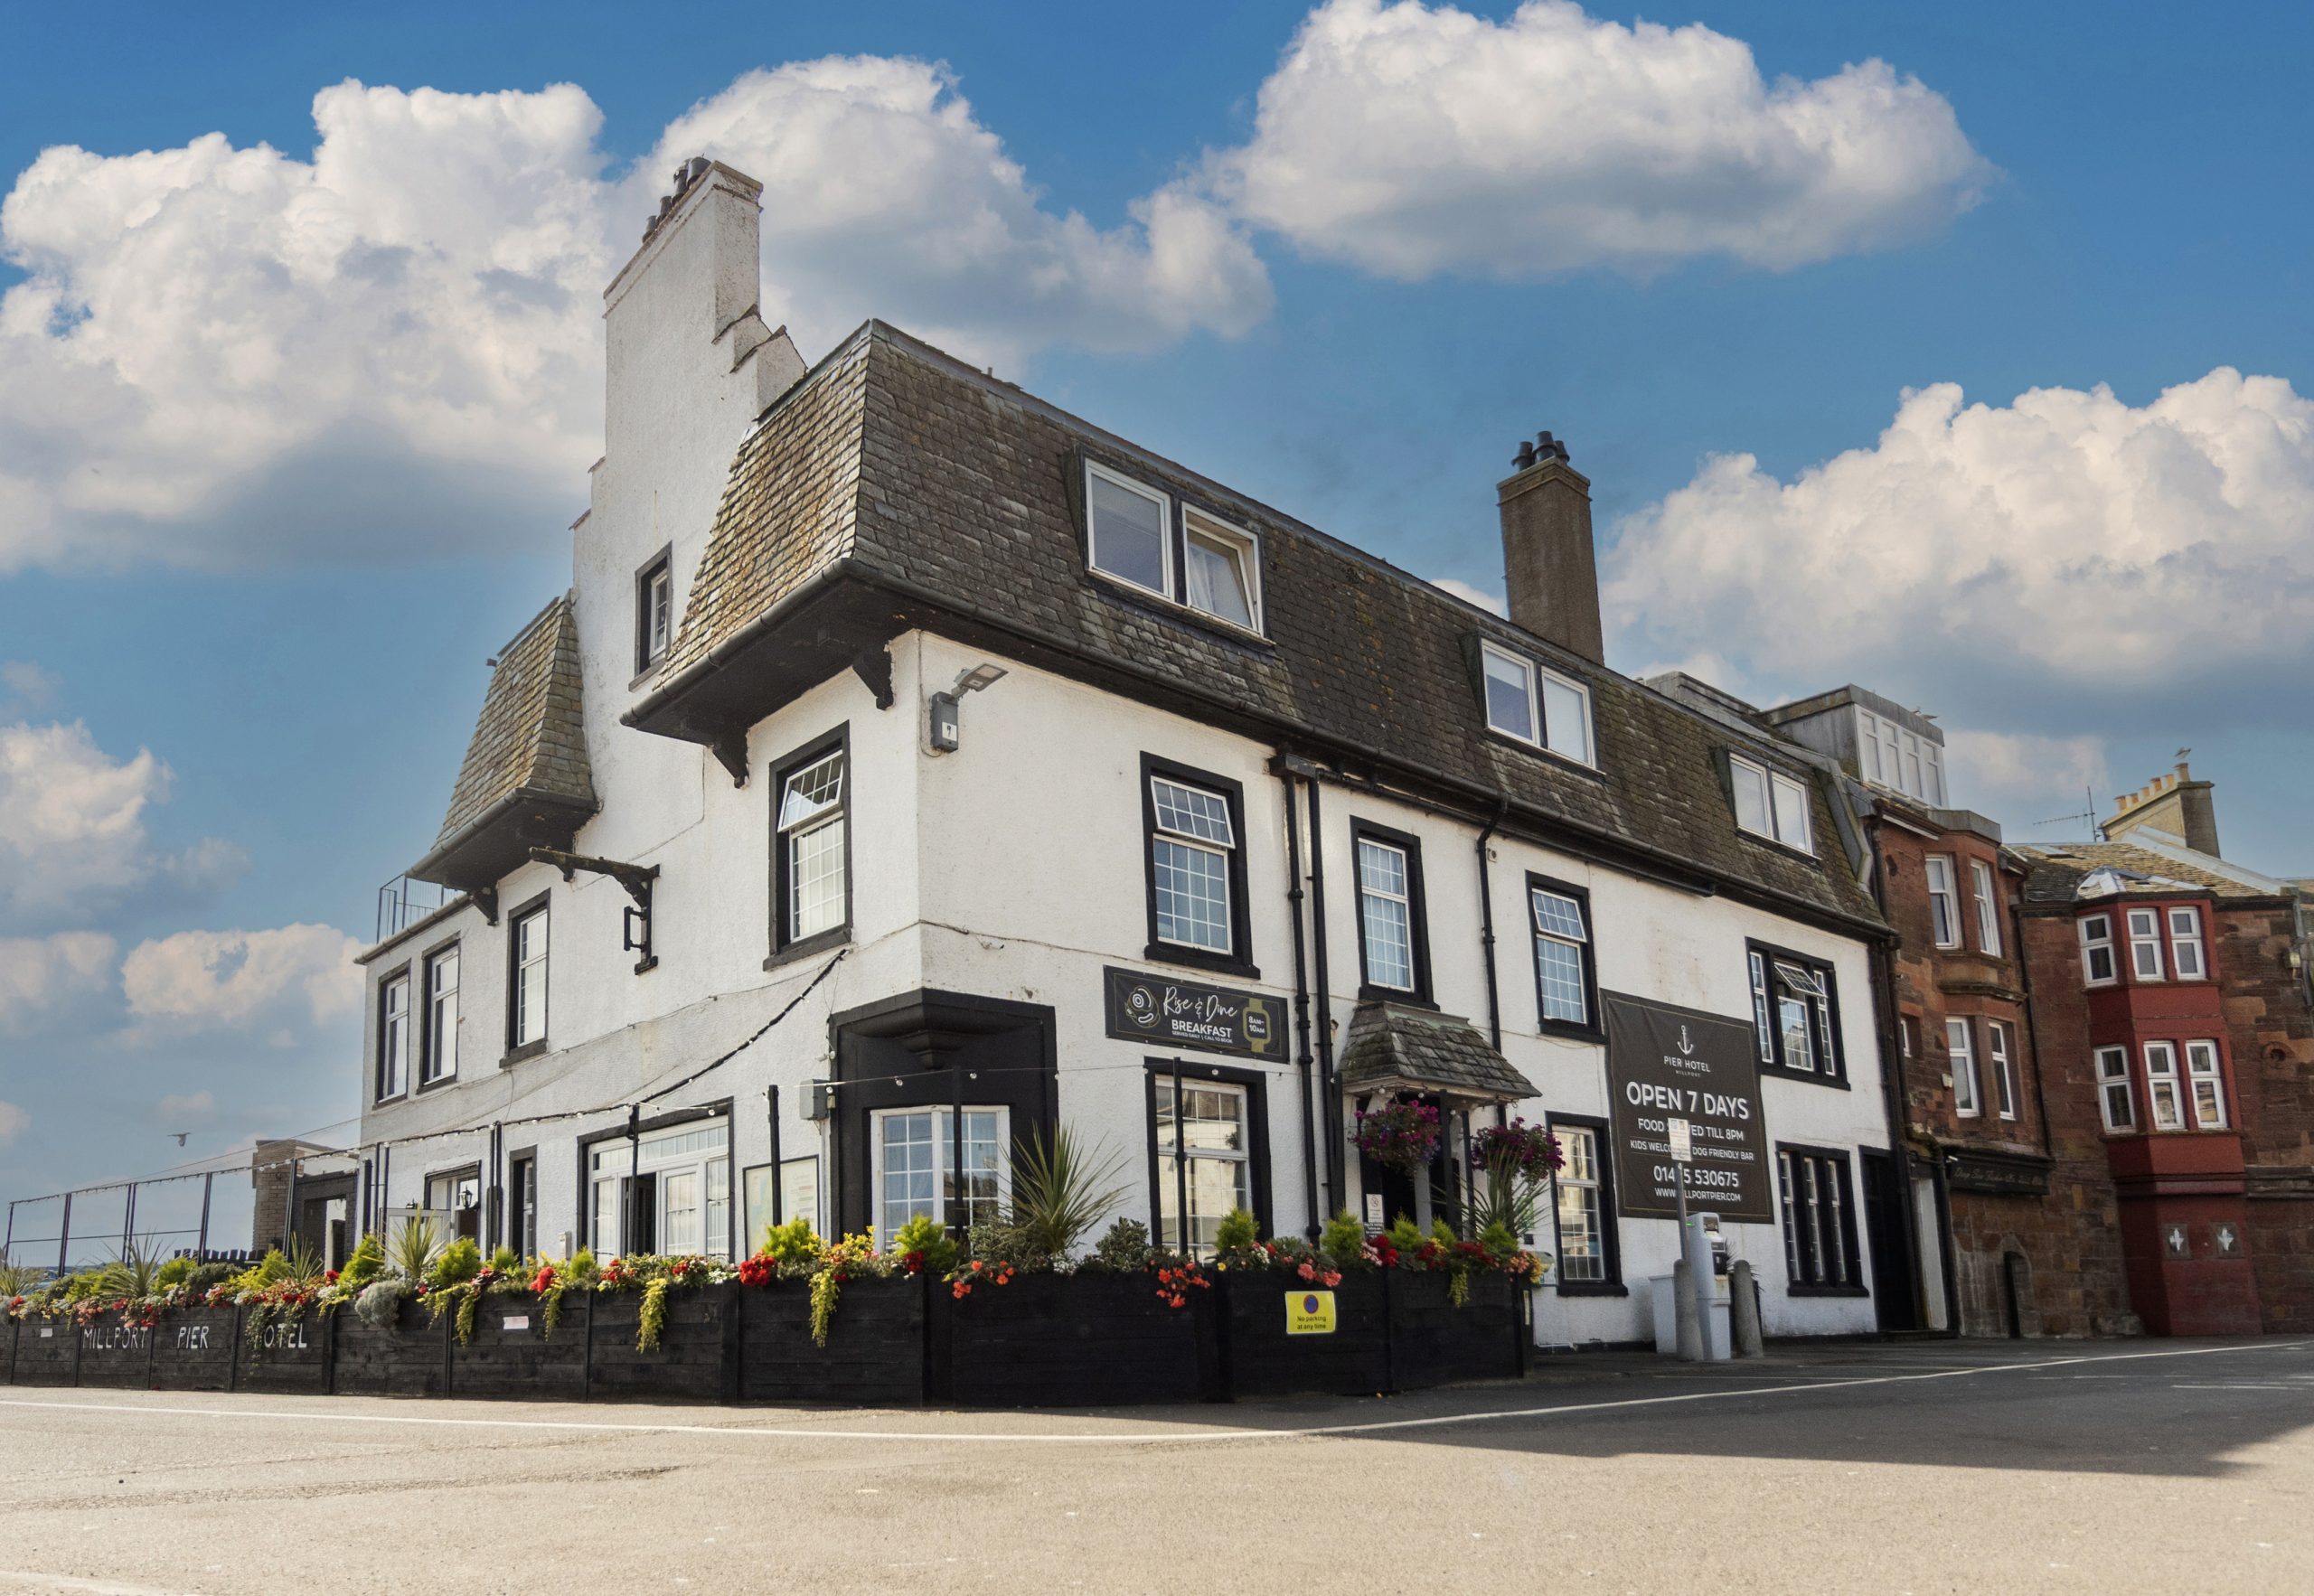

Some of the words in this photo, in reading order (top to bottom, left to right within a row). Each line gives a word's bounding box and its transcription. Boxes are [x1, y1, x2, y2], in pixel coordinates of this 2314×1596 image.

[1163, 986, 1193, 1016] Rise
[1194, 998, 1203, 1019] &
[1206, 994, 1237, 1022] Dine
[1171, 1019, 1232, 1038] BREAKFAST
[1248, 1024, 1265, 1034] 10AM
[1664, 1056, 1681, 1067] PIER
[1685, 1059, 1711, 1073] HOTEL
[1675, 1069, 1701, 1077] MILLPORT
[1626, 1081, 1682, 1111] OPEN
[1687, 1090, 1698, 1113] 7
[1703, 1093, 1750, 1120] DAYS
[1638, 1117, 1665, 1132] FOOD
[1706, 1126, 1724, 1140] TILL
[1726, 1128, 1745, 1141] 8PM
[1630, 1140, 1648, 1150] KIDS
[1648, 1141, 1671, 1152] WELCO
[1692, 1146, 1708, 1156] DOG
[1709, 1148, 1740, 1159] FRIENDLY
[1740, 1151, 1754, 1161] BAR
[1653, 1165, 1691, 1184] 0145
[1694, 1169, 1740, 1188] 530675
[82, 1326, 148, 1349] MILLPORT
[177, 1326, 210, 1349] PIER
[254, 1323, 307, 1348] OTEL
